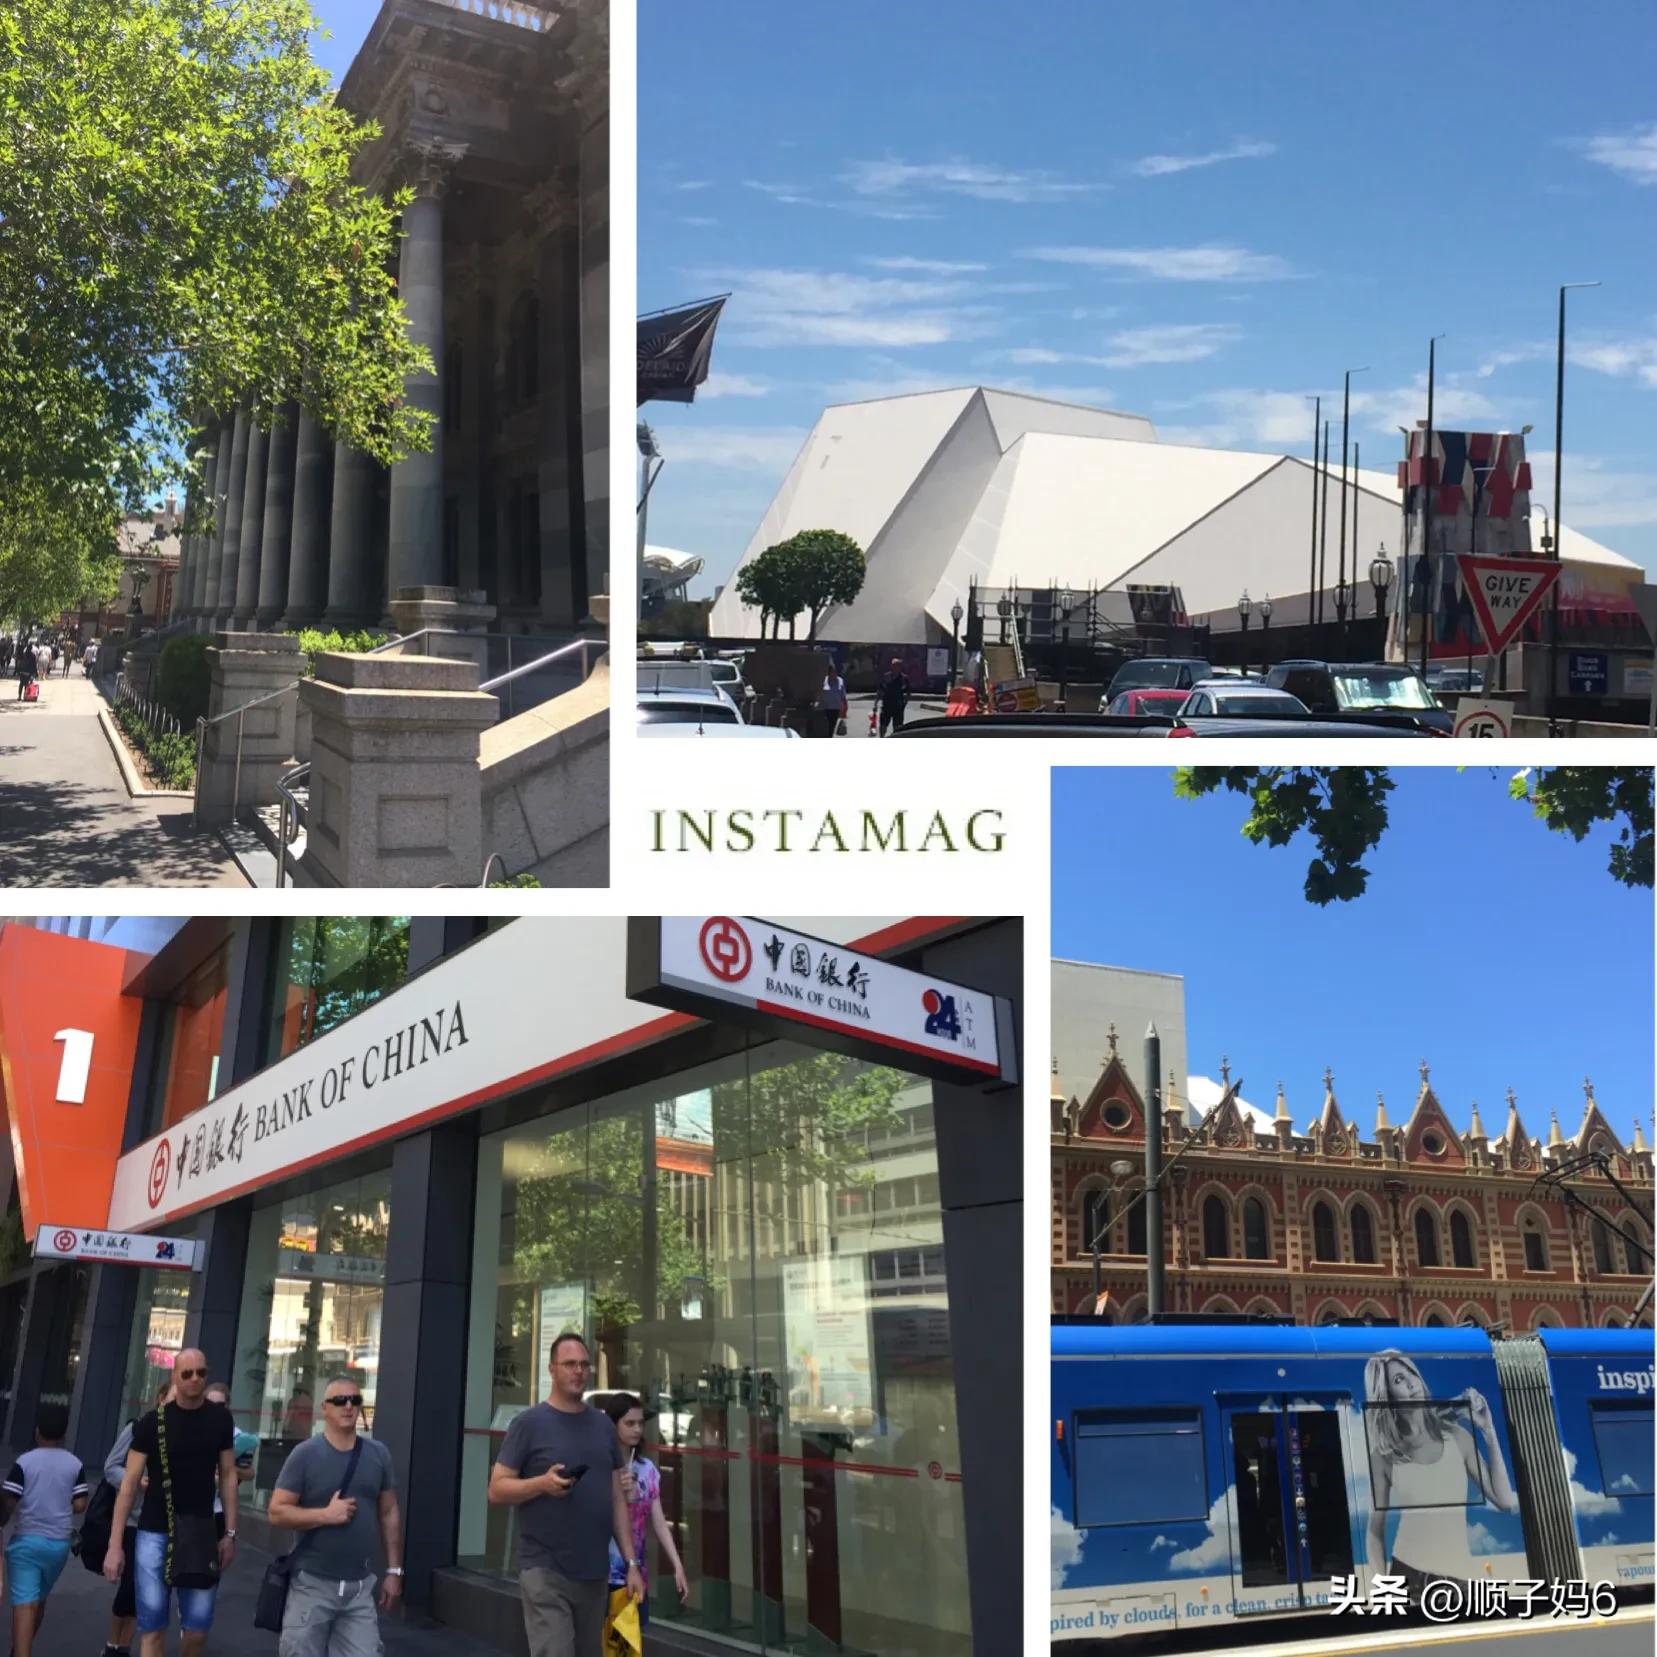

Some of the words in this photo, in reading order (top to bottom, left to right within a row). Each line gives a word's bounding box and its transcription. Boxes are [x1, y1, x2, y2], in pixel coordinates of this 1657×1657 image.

[1486, 575, 1531, 593] GIVE
[1491, 595, 1522, 608] WAY
[1469, 723, 1495, 738] 15
[766, 977, 804, 1000] BANK
[807, 990, 825, 1006] OF
[828, 996, 871, 1019] CHINA
[54, 1028, 95, 1104] 1
[254, 1079, 314, 1142] BANK
[321, 1057, 355, 1108] OF
[362, 1000, 469, 1089] CHINA
[1051, 1611, 1094, 1634] pired
[1100, 1610, 1119, 1628] by
[1186, 1601, 1208, 1617] for
[1212, 1604, 1221, 1616] a
